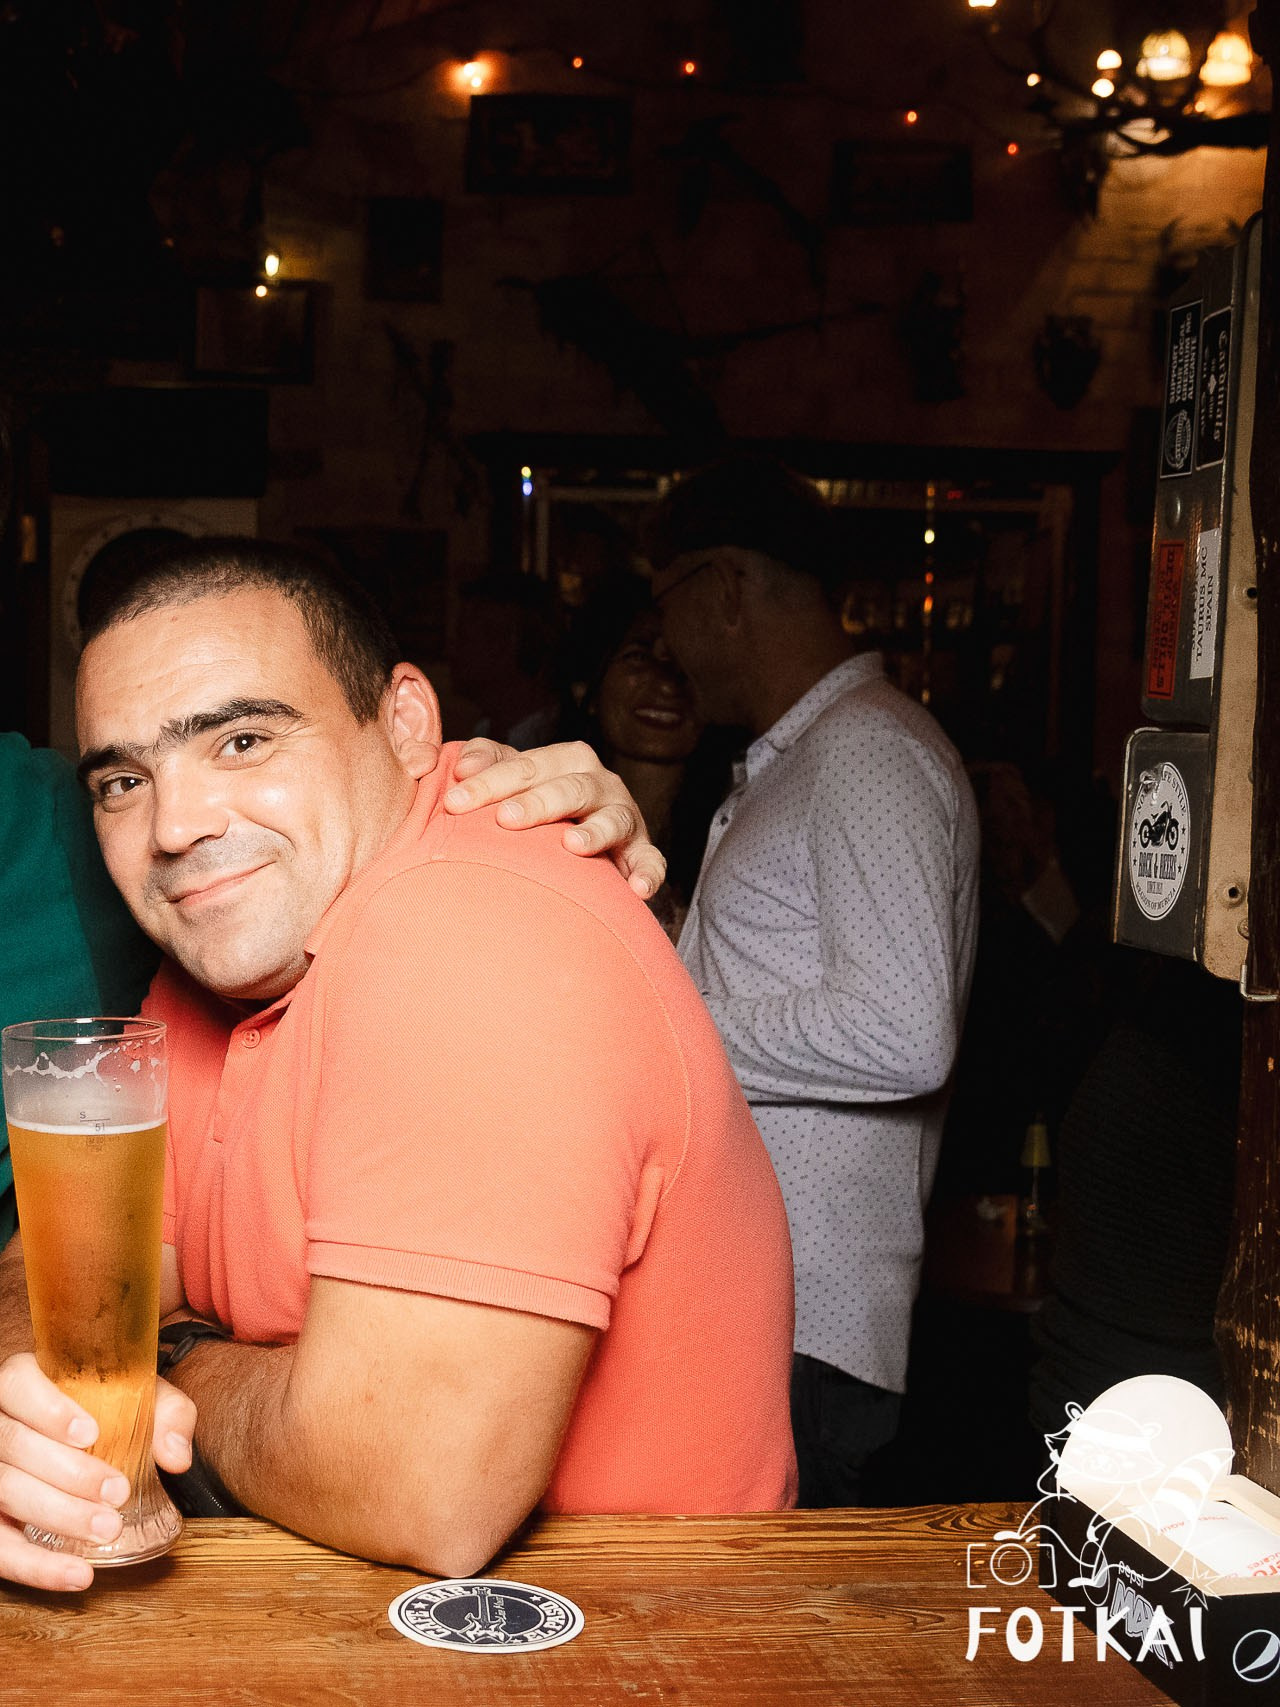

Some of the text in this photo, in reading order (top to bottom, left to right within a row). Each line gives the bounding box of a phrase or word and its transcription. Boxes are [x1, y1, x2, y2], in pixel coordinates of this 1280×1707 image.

[1169, 343, 1179, 404] SUPPORT
[1175, 321, 1186, 402] YOUR LOCAL
[1182, 337, 1191, 401] GREMIUM
[1188, 335, 1197, 400] ALICANTE
[1213, 330, 1228, 441] Cardinals
[1200, 546, 1208, 578] MC
[1195, 585, 1206, 661] TAURUS
[1205, 575, 1214, 632] SPAIN
[1118, 1560, 1144, 1589] pepsi
[406, 1586, 567, 1642] CAFE BAR EL PASO
